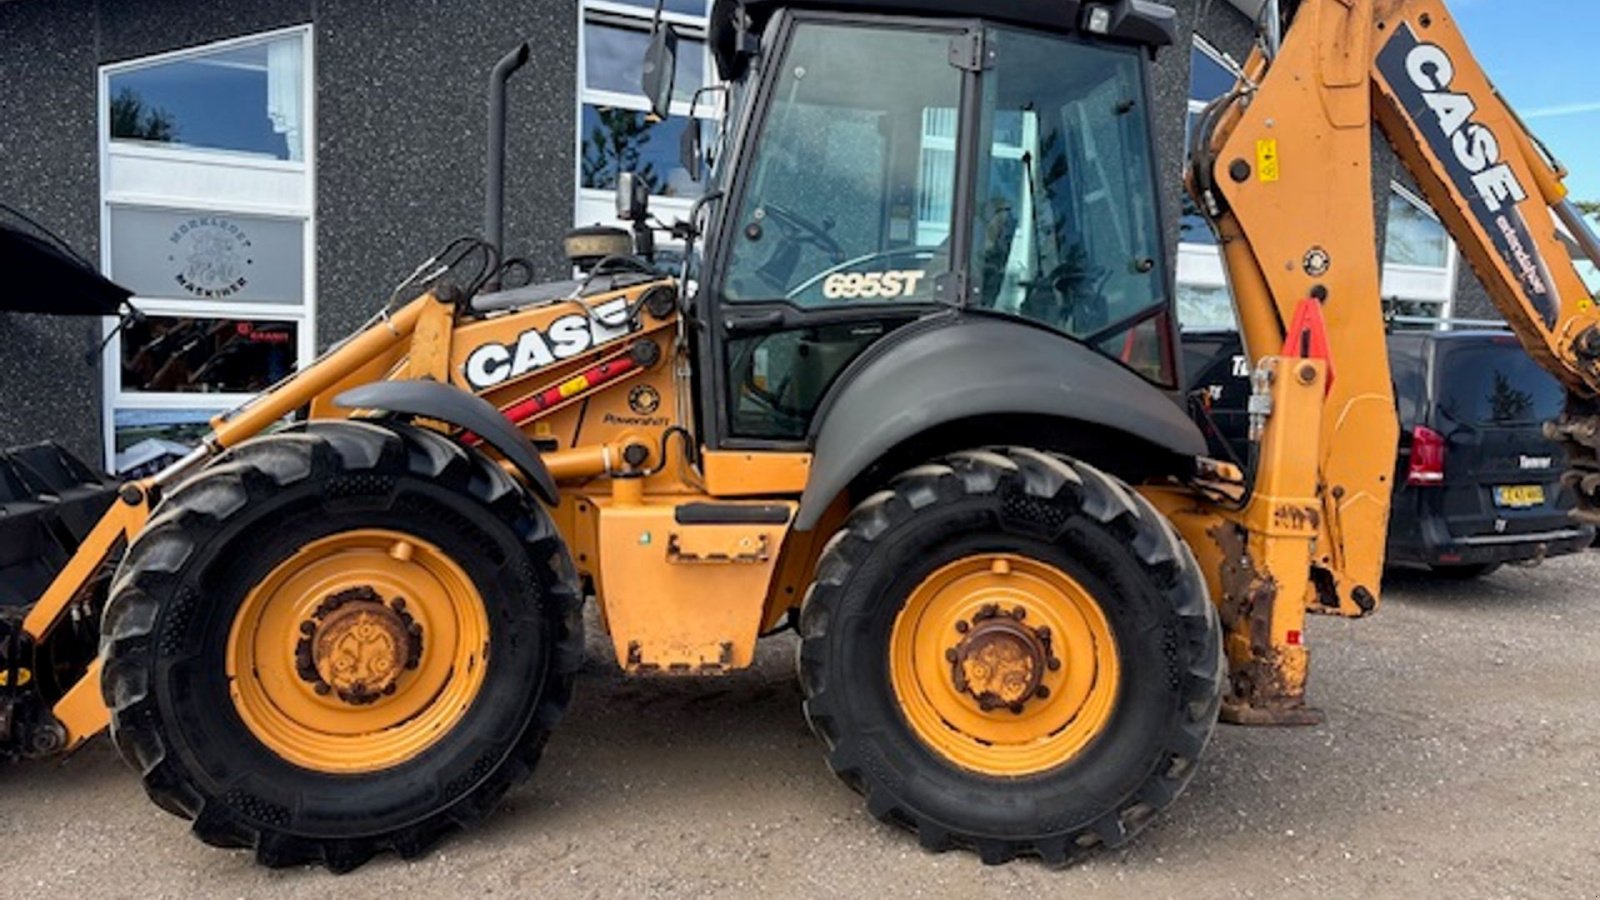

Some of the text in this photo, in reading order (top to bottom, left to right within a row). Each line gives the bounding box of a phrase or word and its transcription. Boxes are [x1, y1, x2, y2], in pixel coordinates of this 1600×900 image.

[1405, 43, 1527, 213] CASE
[175, 273, 247, 298] MASKINER
[822, 269, 927, 300] 695ST
[465, 296, 634, 389] CASE
